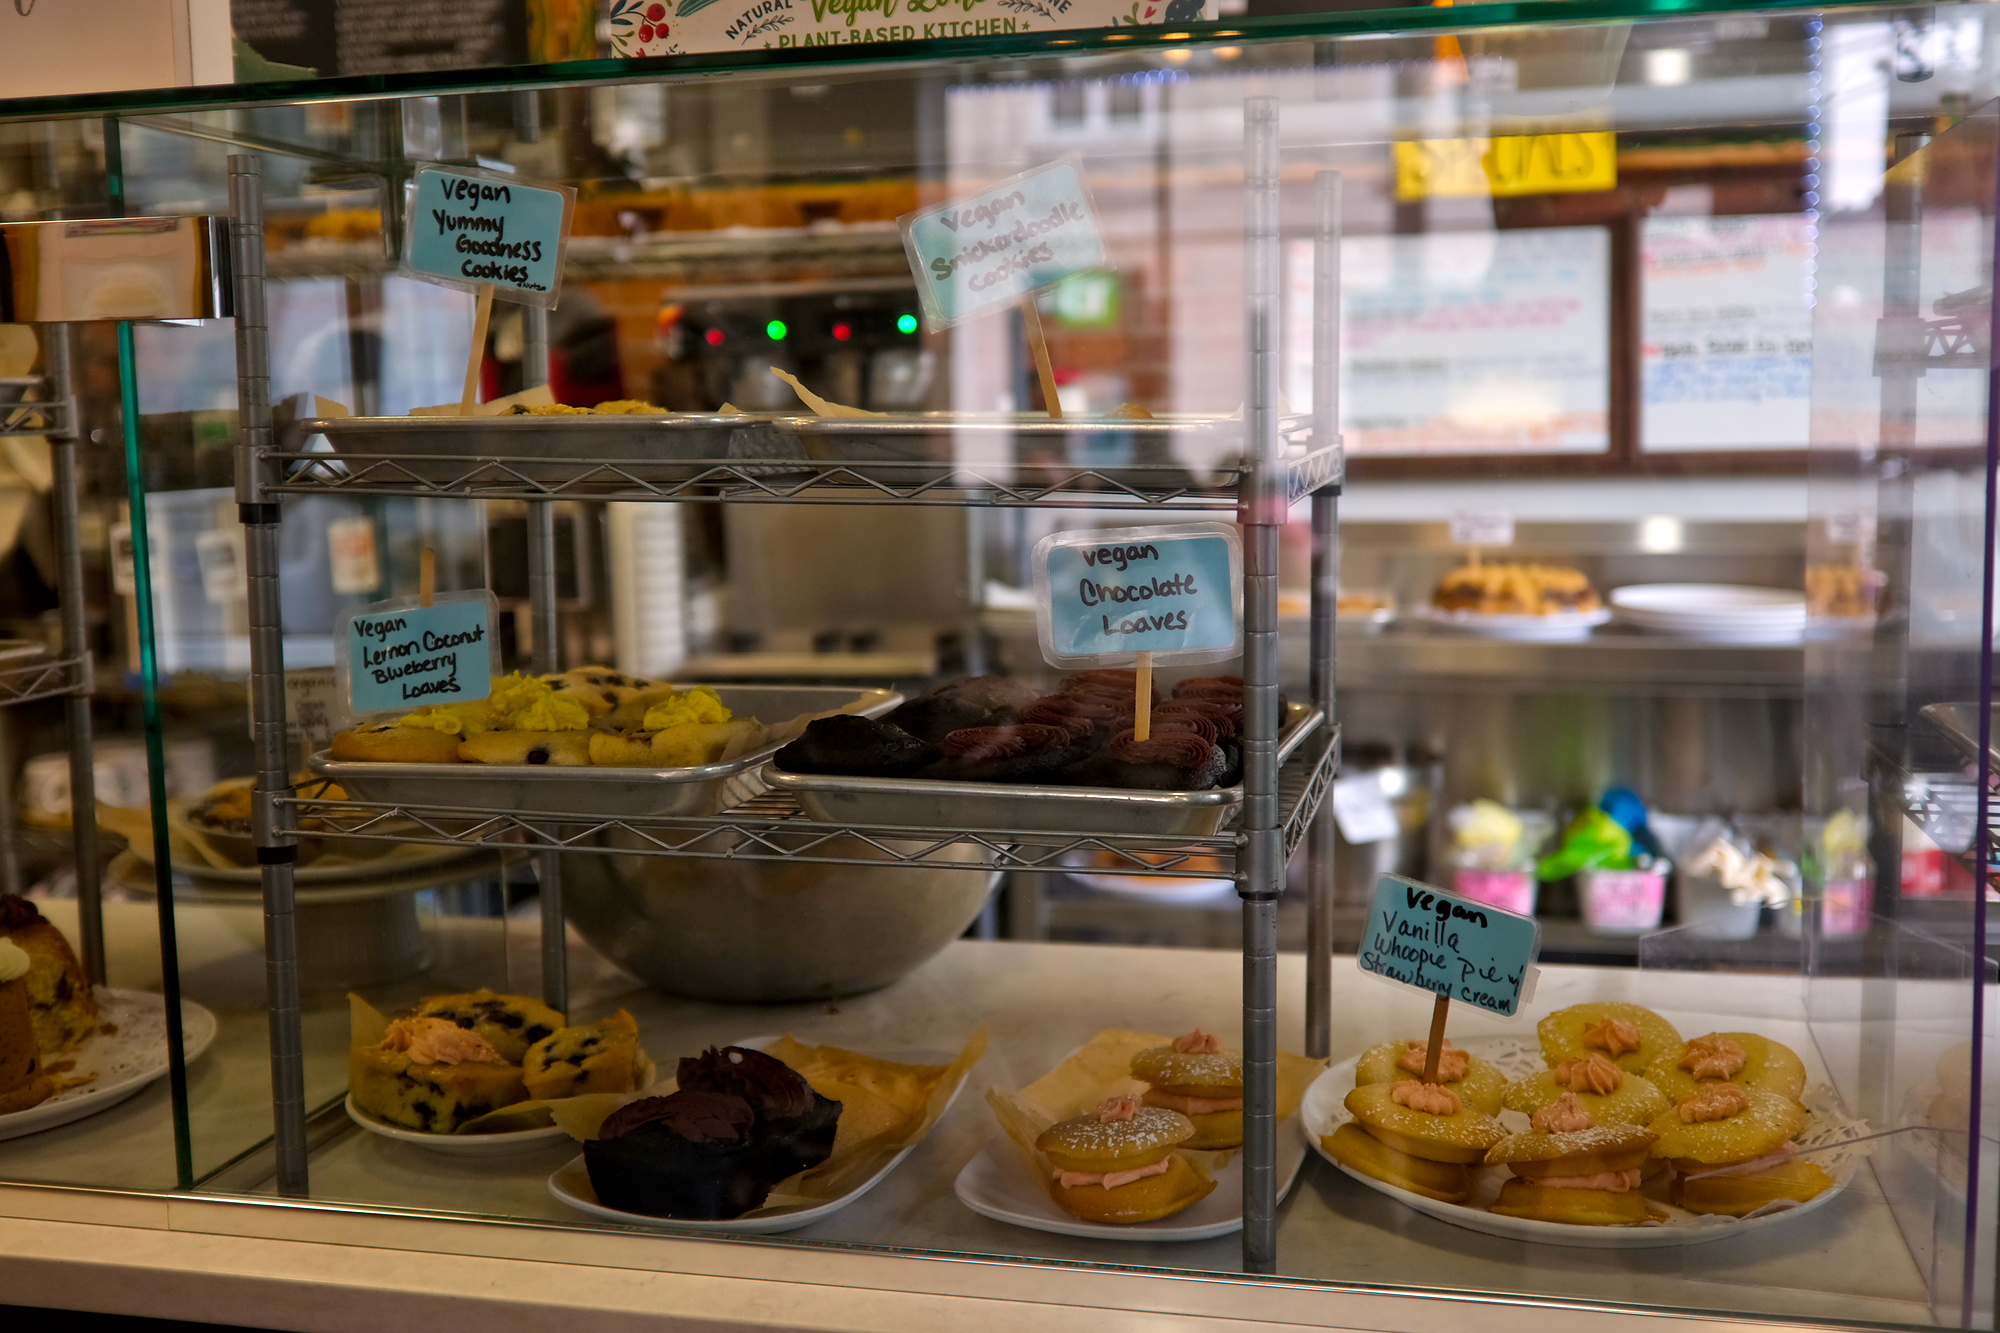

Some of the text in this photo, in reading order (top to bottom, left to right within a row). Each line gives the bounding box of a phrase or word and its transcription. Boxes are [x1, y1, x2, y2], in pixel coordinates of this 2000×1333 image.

[725, 0, 793, 40] NATURAL
[779, 17, 1017, 48] PLANT-BASED KITCHEN
[432, 208, 504, 240] Yummy
[455, 233, 542, 262] Goodness
[461, 259, 529, 282] Cookies
[1080, 573, 1197, 606] Chocolate
[354, 618, 407, 642] Vegan
[1103, 610, 1188, 636] Loaves
[363, 624, 485, 669] Lemon Coconut
[371, 652, 456, 684] Blueberry
[402, 677, 461, 700] Loaves
[1383, 911, 1460, 954] Vanilla
[1457, 957, 1502, 983] Pie
